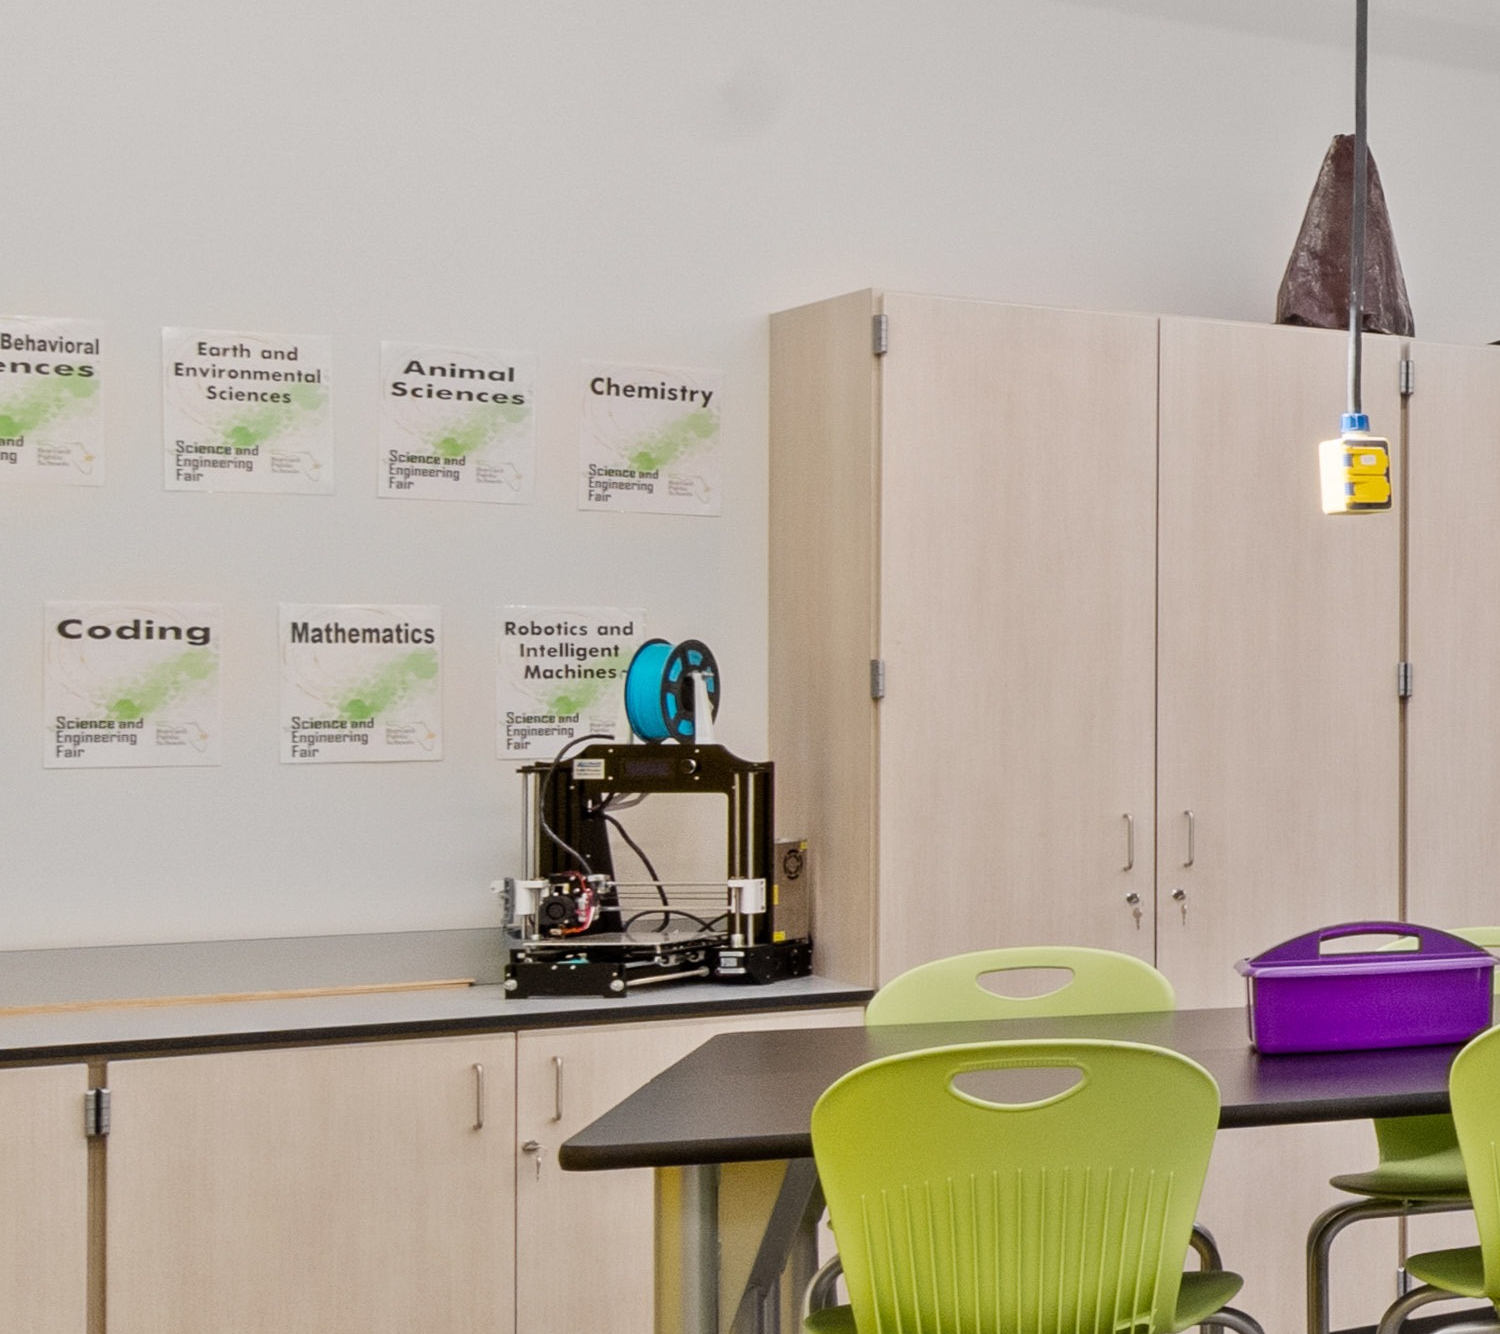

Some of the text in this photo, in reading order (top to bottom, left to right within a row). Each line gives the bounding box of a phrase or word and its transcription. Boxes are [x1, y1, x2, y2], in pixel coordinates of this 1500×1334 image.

[0, 333, 99, 355] Behavioral
[197, 342, 298, 361] Earth and
[0, 361, 95, 378] nces
[174, 362, 321, 383] Environmental
[404, 360, 515, 382] Animal
[206, 385, 292, 403] Sciences
[391, 382, 525, 405] Sciences
[591, 377, 713, 408] Chemistry
[176, 440, 259, 456] Science and
[176, 455, 253, 471] Engineering
[389, 450, 466, 466] Science and
[176, 468, 204, 481] Fair
[389, 466, 460, 481] Engineering
[588, 463, 659, 480] Science and
[389, 478, 415, 490] Fair
[588, 479, 654, 493] Engineering
[588, 491, 611, 502] Fair
[57, 619, 211, 646] Coding
[291, 621, 435, 644] Mathematics
[504, 621, 633, 636] Robotics and
[520, 644, 619, 660] Intelligent
[524, 665, 617, 679] Machines
[56, 716, 144, 729] Science and
[292, 716, 375, 729] Science and
[506, 712, 579, 724] Science and
[56, 731, 137, 745] Engineering
[292, 731, 368, 745] Engineering
[506, 726, 574, 738] Engineering
[56, 745, 85, 758] Fair
[292, 745, 319, 758] Fair
[506, 738, 531, 750] Fair
